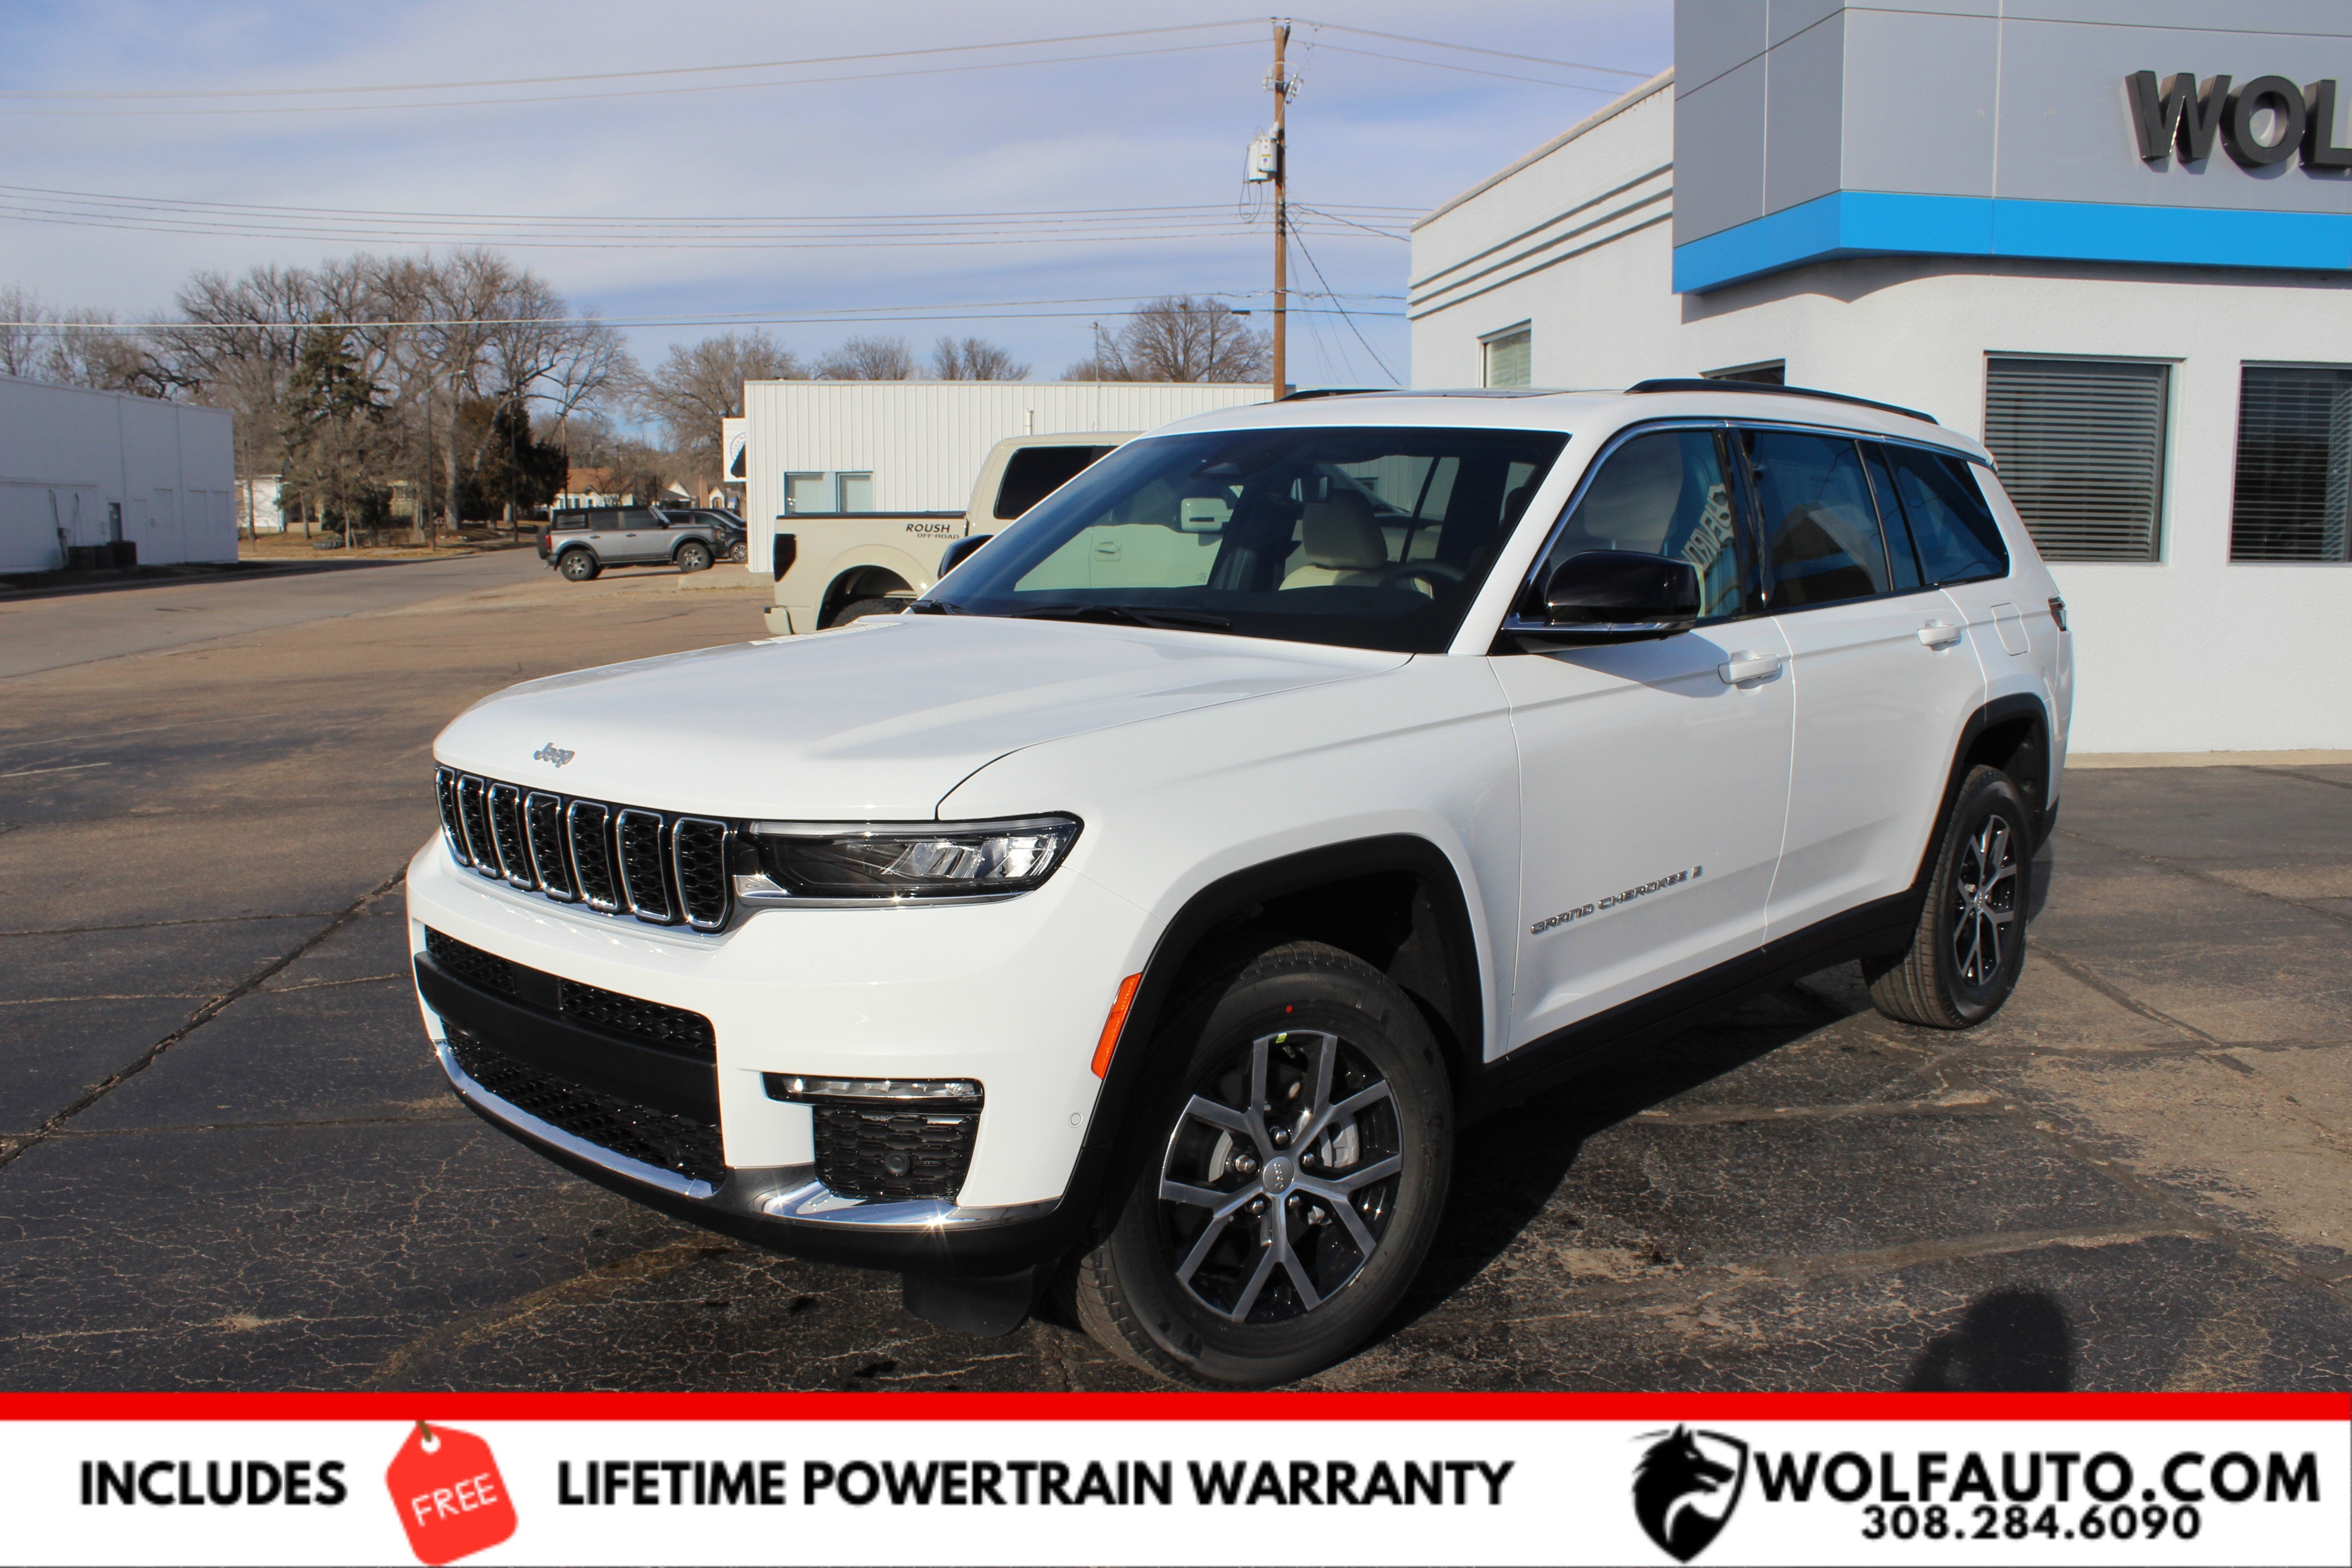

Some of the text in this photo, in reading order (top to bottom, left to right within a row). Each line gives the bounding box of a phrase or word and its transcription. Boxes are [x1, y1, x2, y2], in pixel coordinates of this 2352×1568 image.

[906, 524, 951, 533] ROUSH
[533, 742, 575, 769] Jeep
[1531, 870, 1687, 935] GRAND CHEROKEE
